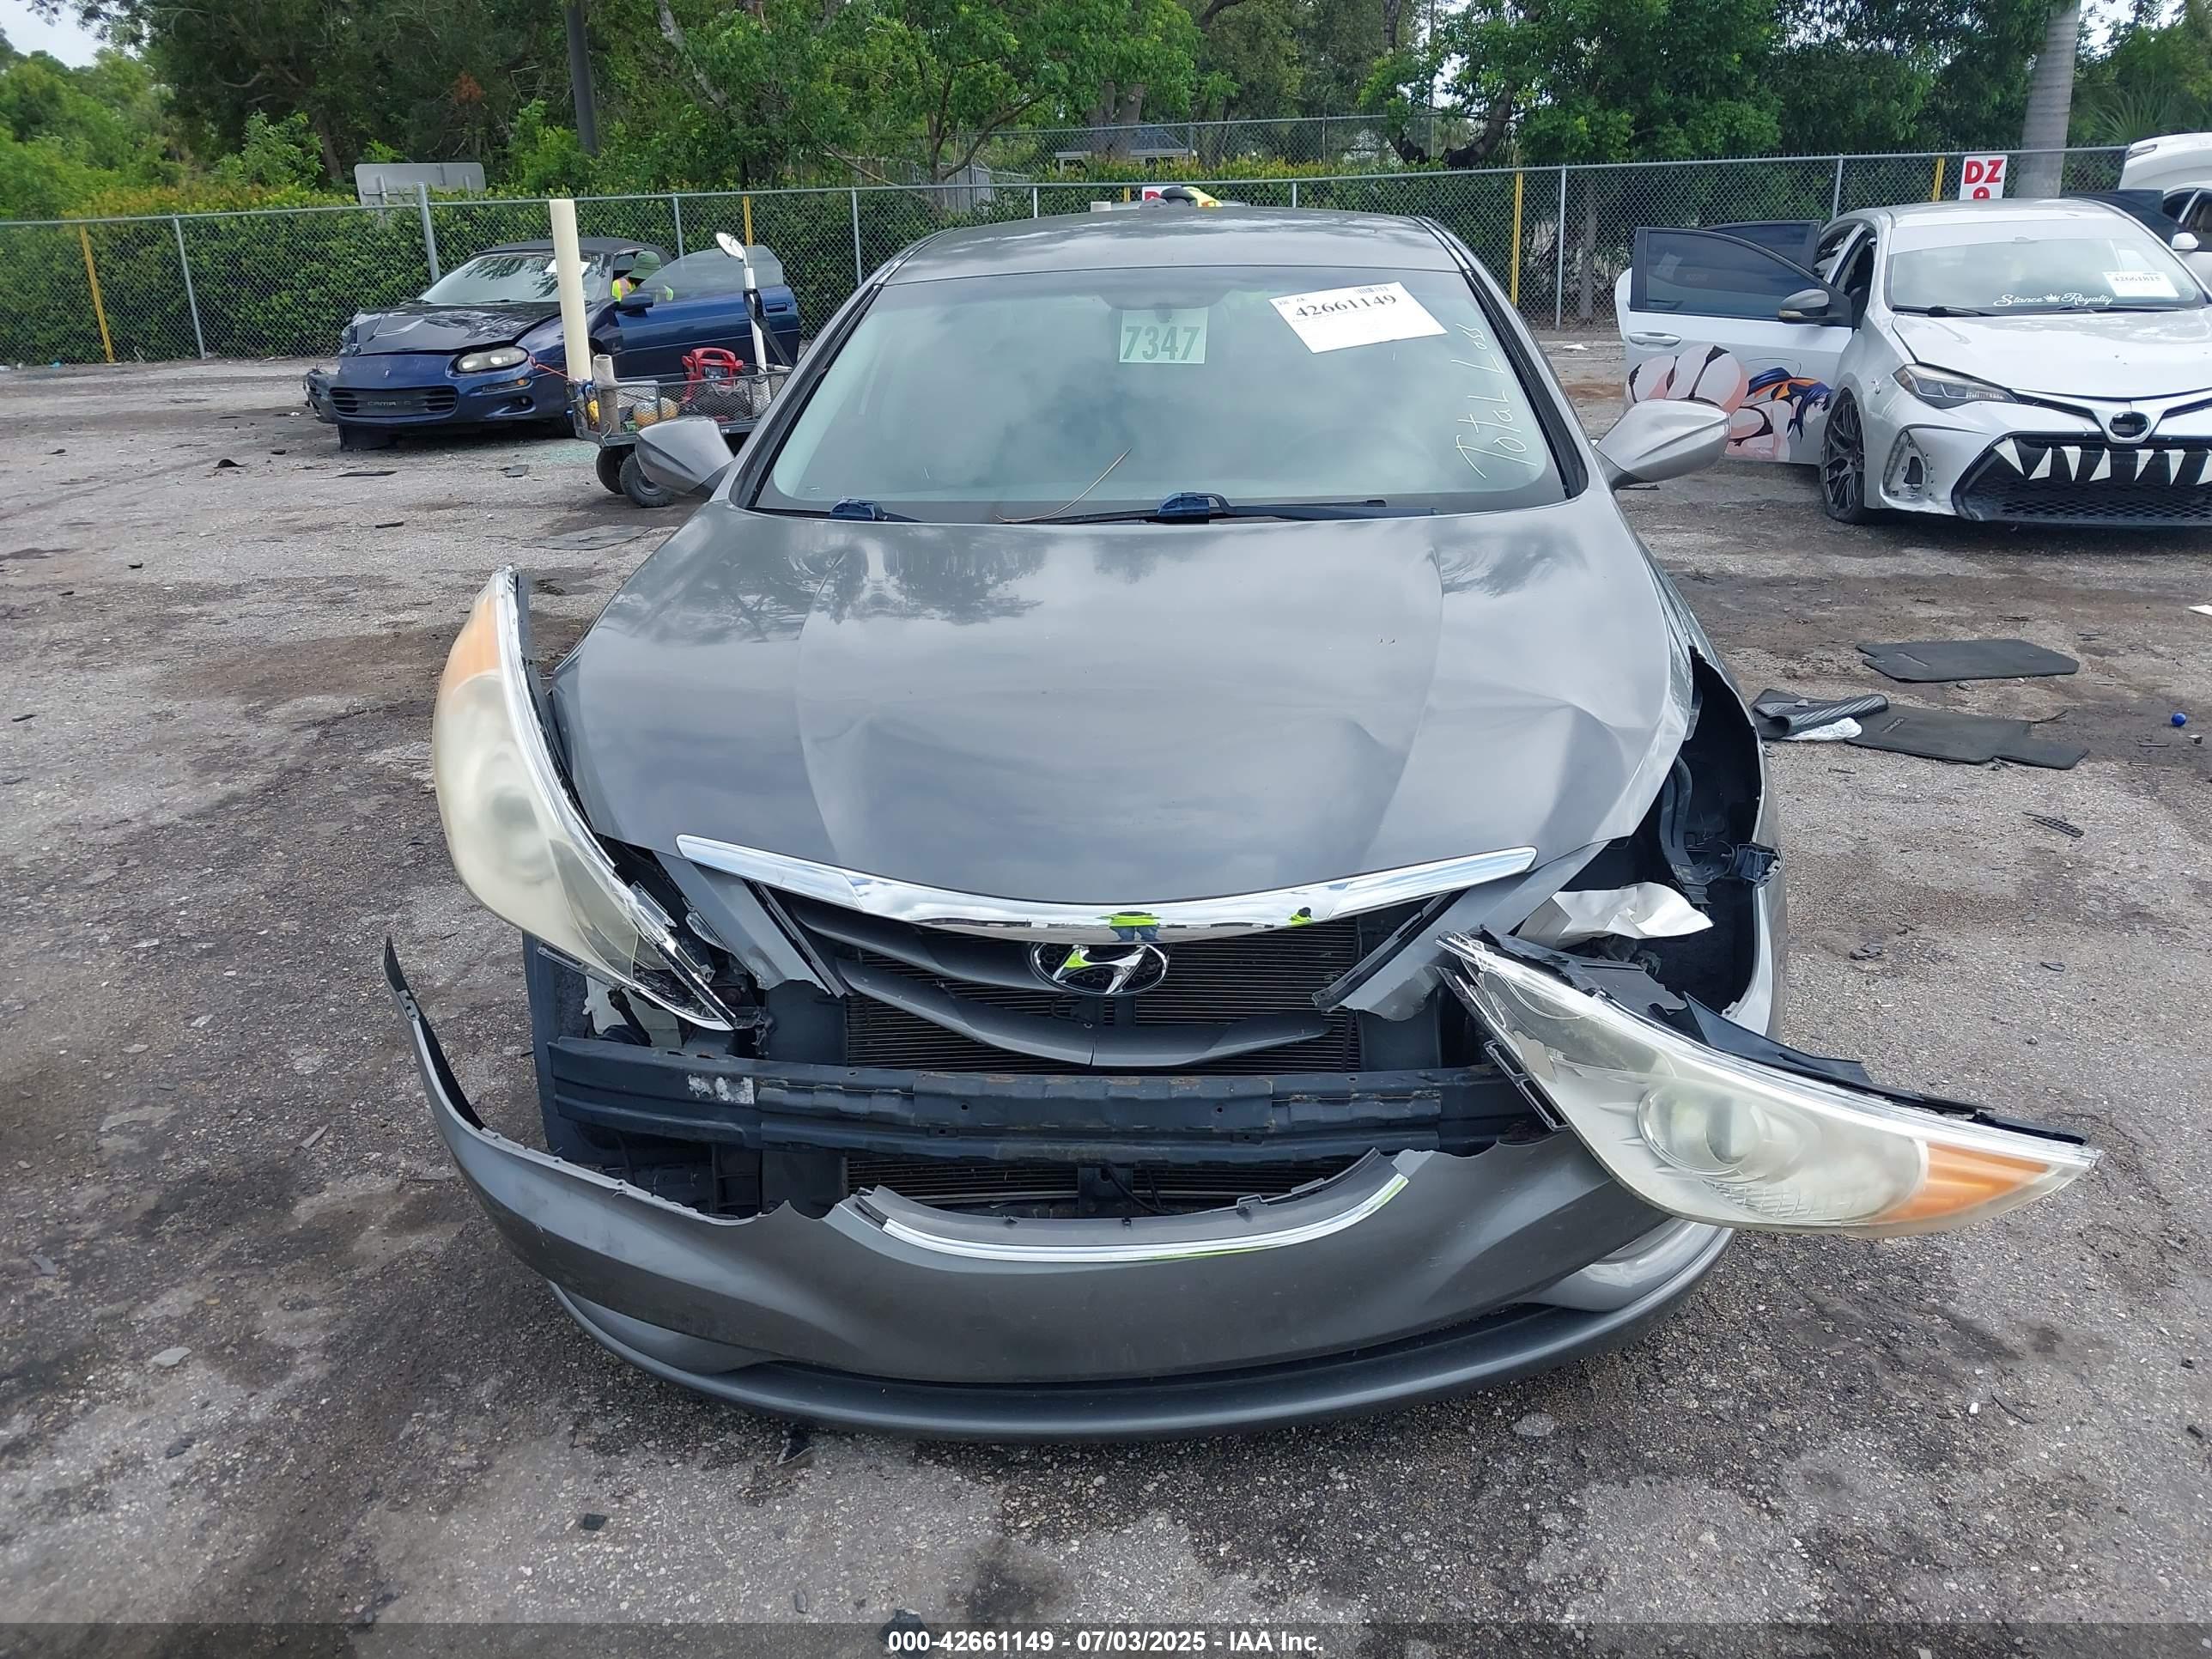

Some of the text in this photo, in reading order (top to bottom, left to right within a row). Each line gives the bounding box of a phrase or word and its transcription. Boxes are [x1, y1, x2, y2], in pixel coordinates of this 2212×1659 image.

[1964, 159, 2005, 185] DZ
[1295, 294, 1397, 318] 42661149
[1993, 292, 2113, 307] Stance Royalty
[1122, 325, 1201, 361] 7347
